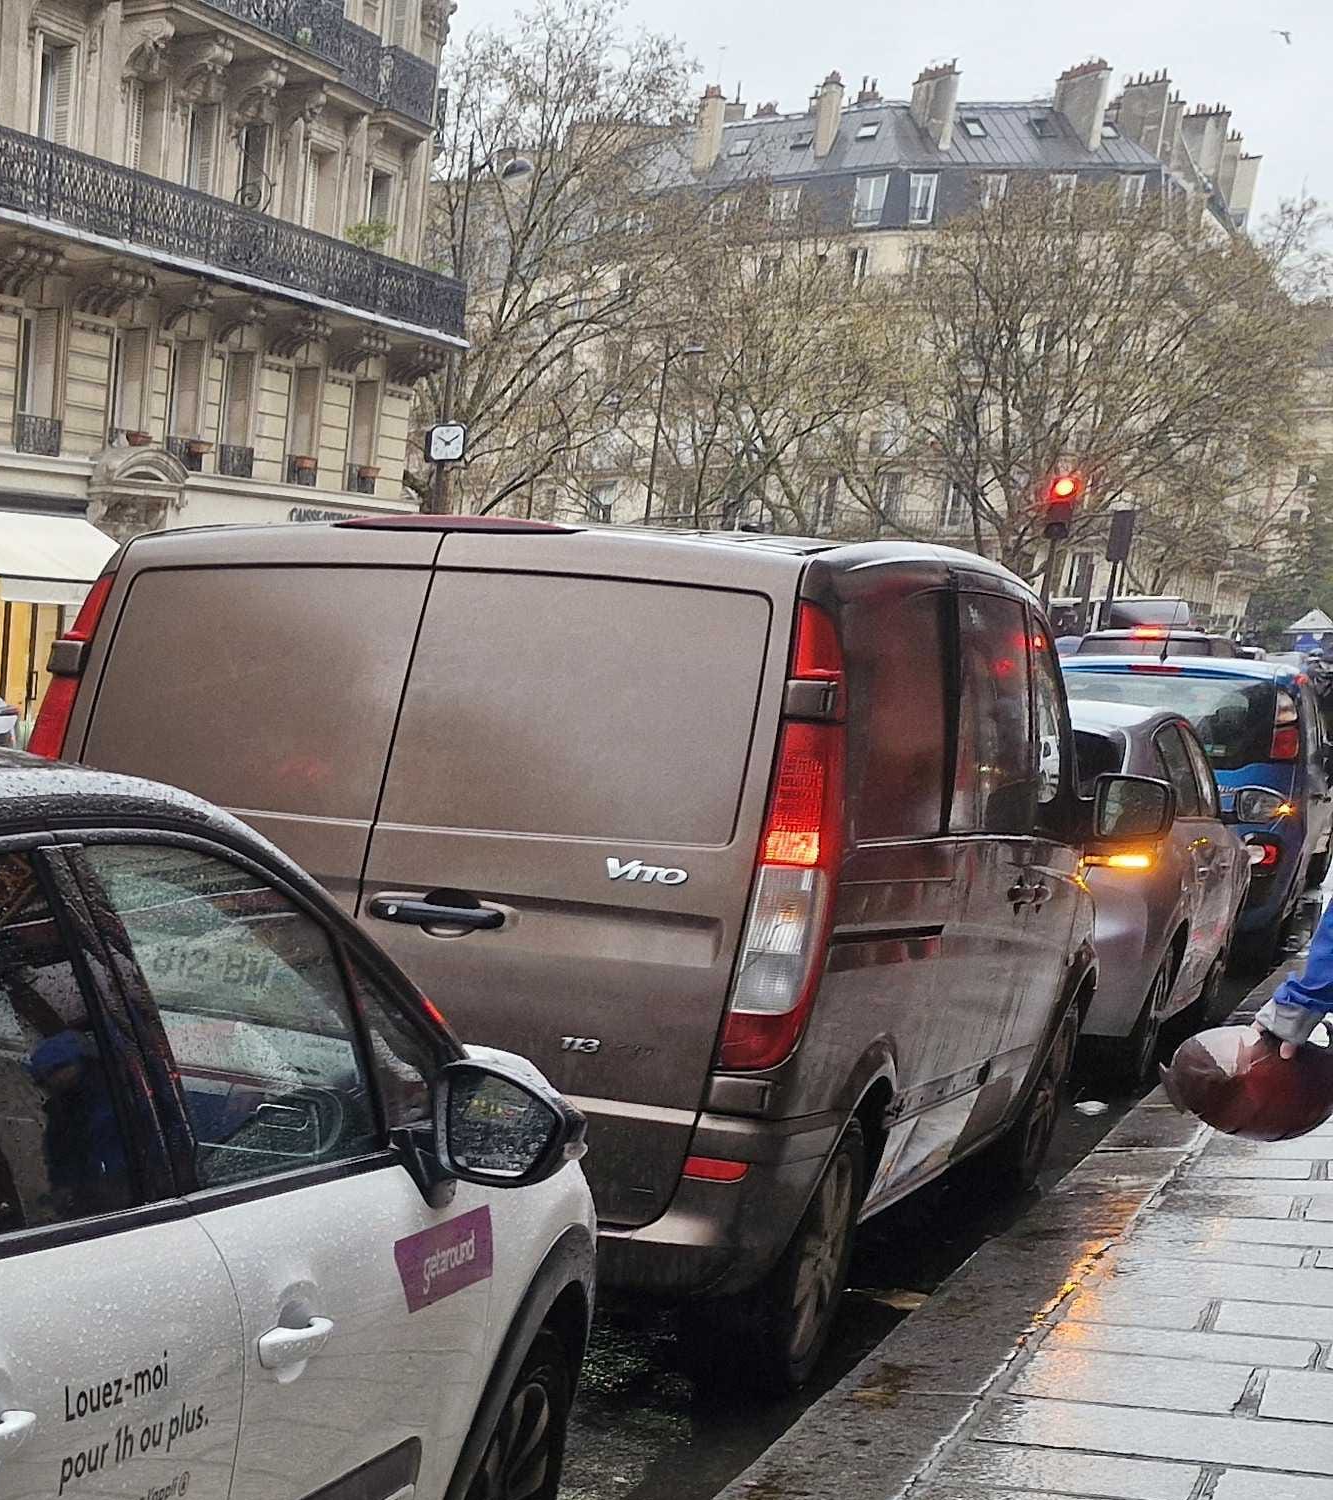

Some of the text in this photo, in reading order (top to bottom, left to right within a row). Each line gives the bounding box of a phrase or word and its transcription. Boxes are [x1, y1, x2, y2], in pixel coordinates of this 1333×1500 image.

[64, 1349, 169, 1422] Louez-moi
[59, 1402, 209, 1497] pour 1h ou plus.
